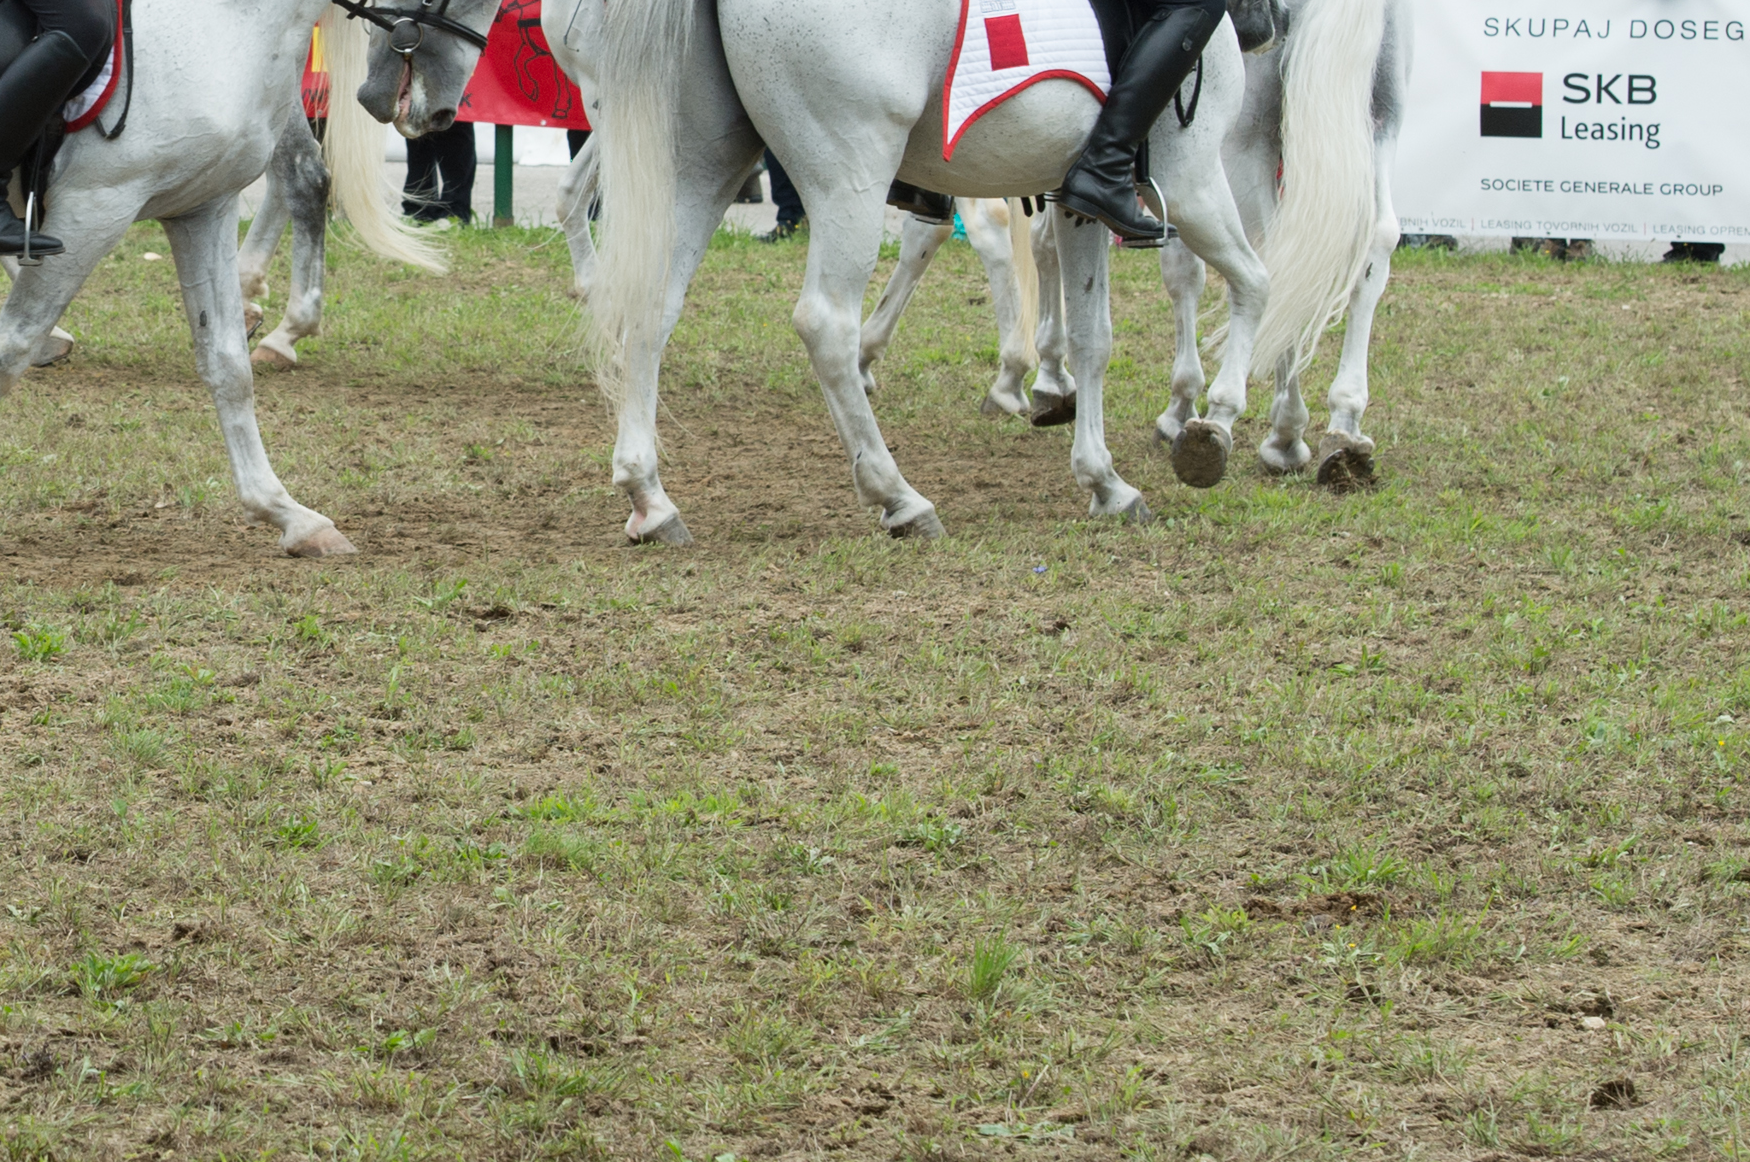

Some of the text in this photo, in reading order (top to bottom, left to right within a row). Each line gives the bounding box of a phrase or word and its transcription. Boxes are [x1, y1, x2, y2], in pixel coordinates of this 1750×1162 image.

[1483, 17, 1744, 41] SKUPAJ DOSEG
[1562, 72, 1657, 105] SKB
[1561, 115, 1661, 150] Leasing
[1480, 178, 1724, 197] SOCIETE GENERALE GROUP
[1396, 216, 1466, 229] BNIH VOZIL
[1480, 218, 1638, 234] LEASING TOVORNIH VOZIL
[1652, 223, 1705, 236] LEASING
